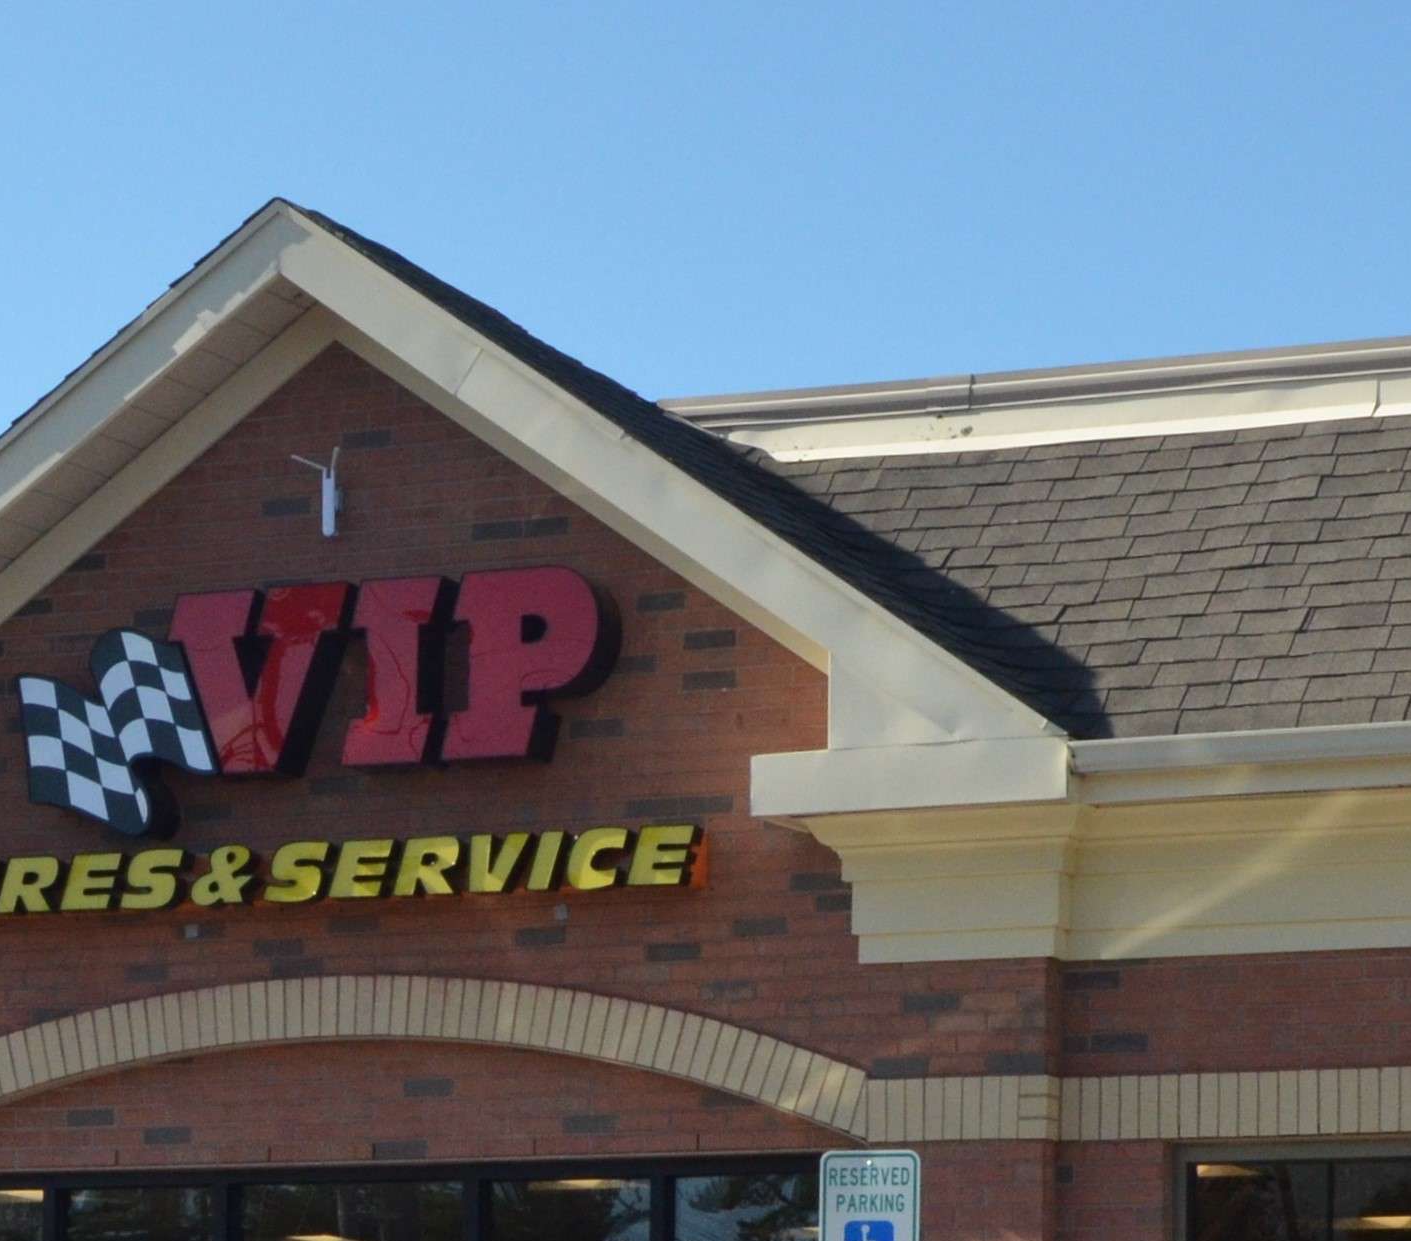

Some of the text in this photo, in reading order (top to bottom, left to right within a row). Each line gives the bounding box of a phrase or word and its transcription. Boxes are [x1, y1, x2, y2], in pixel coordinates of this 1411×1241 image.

[169, 563, 610, 774] VIP
[189, 844, 255, 907] &
[262, 824, 696, 903] SERVICE
[828, 1167, 911, 1187] RESERVED
[835, 1194, 906, 1213] PARKING
